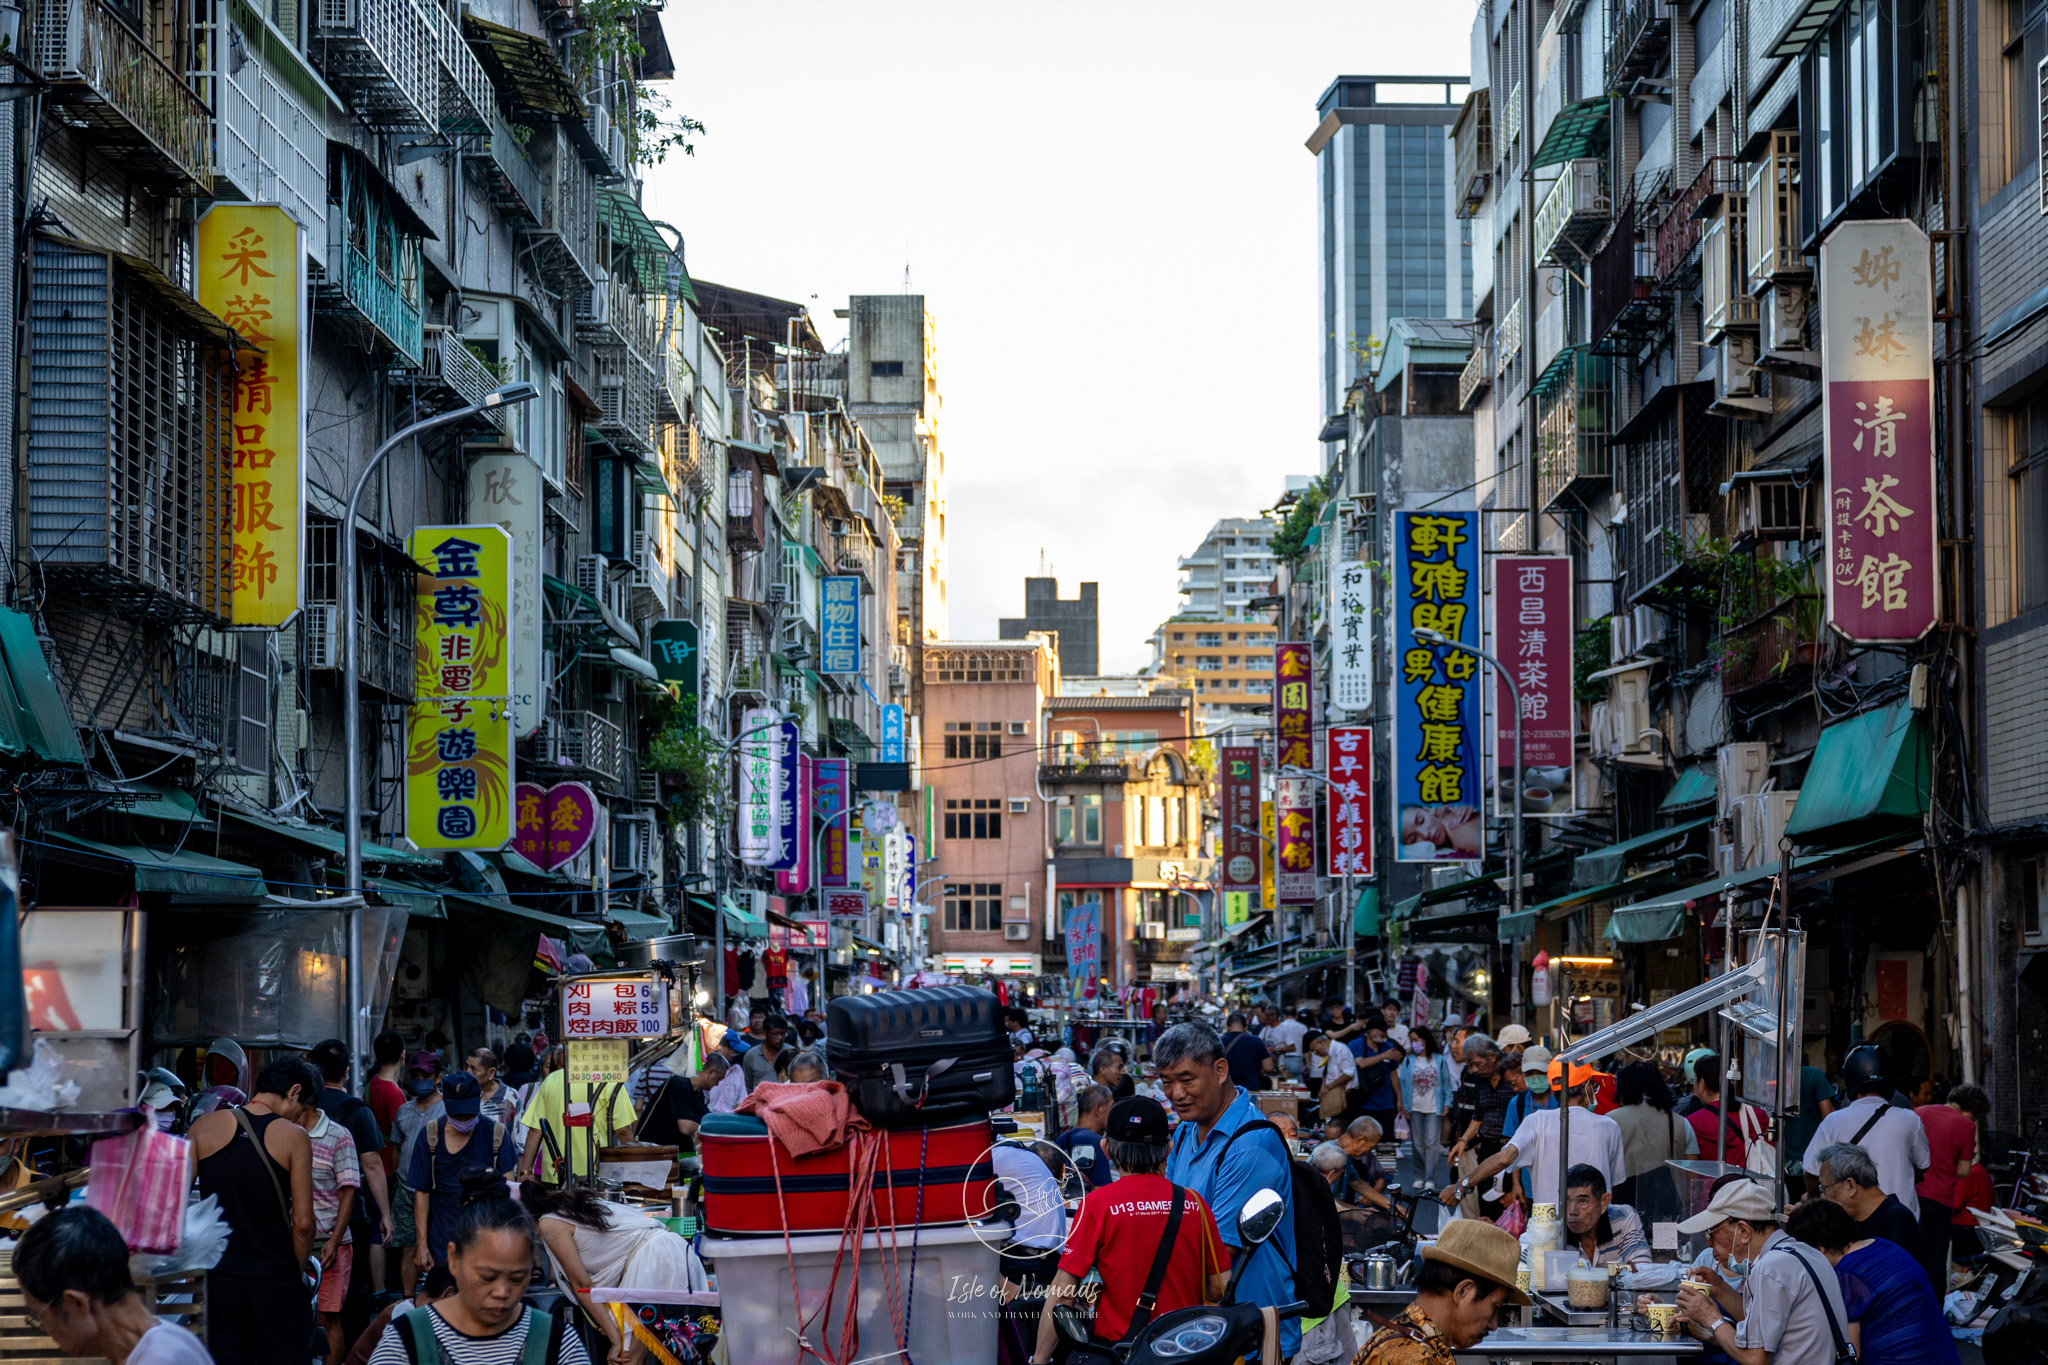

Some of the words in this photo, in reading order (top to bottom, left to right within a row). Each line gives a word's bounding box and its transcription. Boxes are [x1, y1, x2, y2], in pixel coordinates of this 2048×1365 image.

[1852, 245, 1914, 612] 姊妹清茶館
[825, 580, 855, 670] 寵物住宿
[1341, 568, 1364, 669] 和裕實業
[1518, 566, 1548, 721] 西昌清茶館
[516, 794, 583, 832] 真愛
[829, 895, 864, 916] 藥
[641, 1001, 659, 1014] 55
[568, 1018, 638, 1034] 焢肉飯
[641, 1020, 660, 1033] 100
[602, 1073, 611, 1081] 50
[1110, 1201, 1135, 1215] U13
[1183, 1200, 1200, 1212] 017
